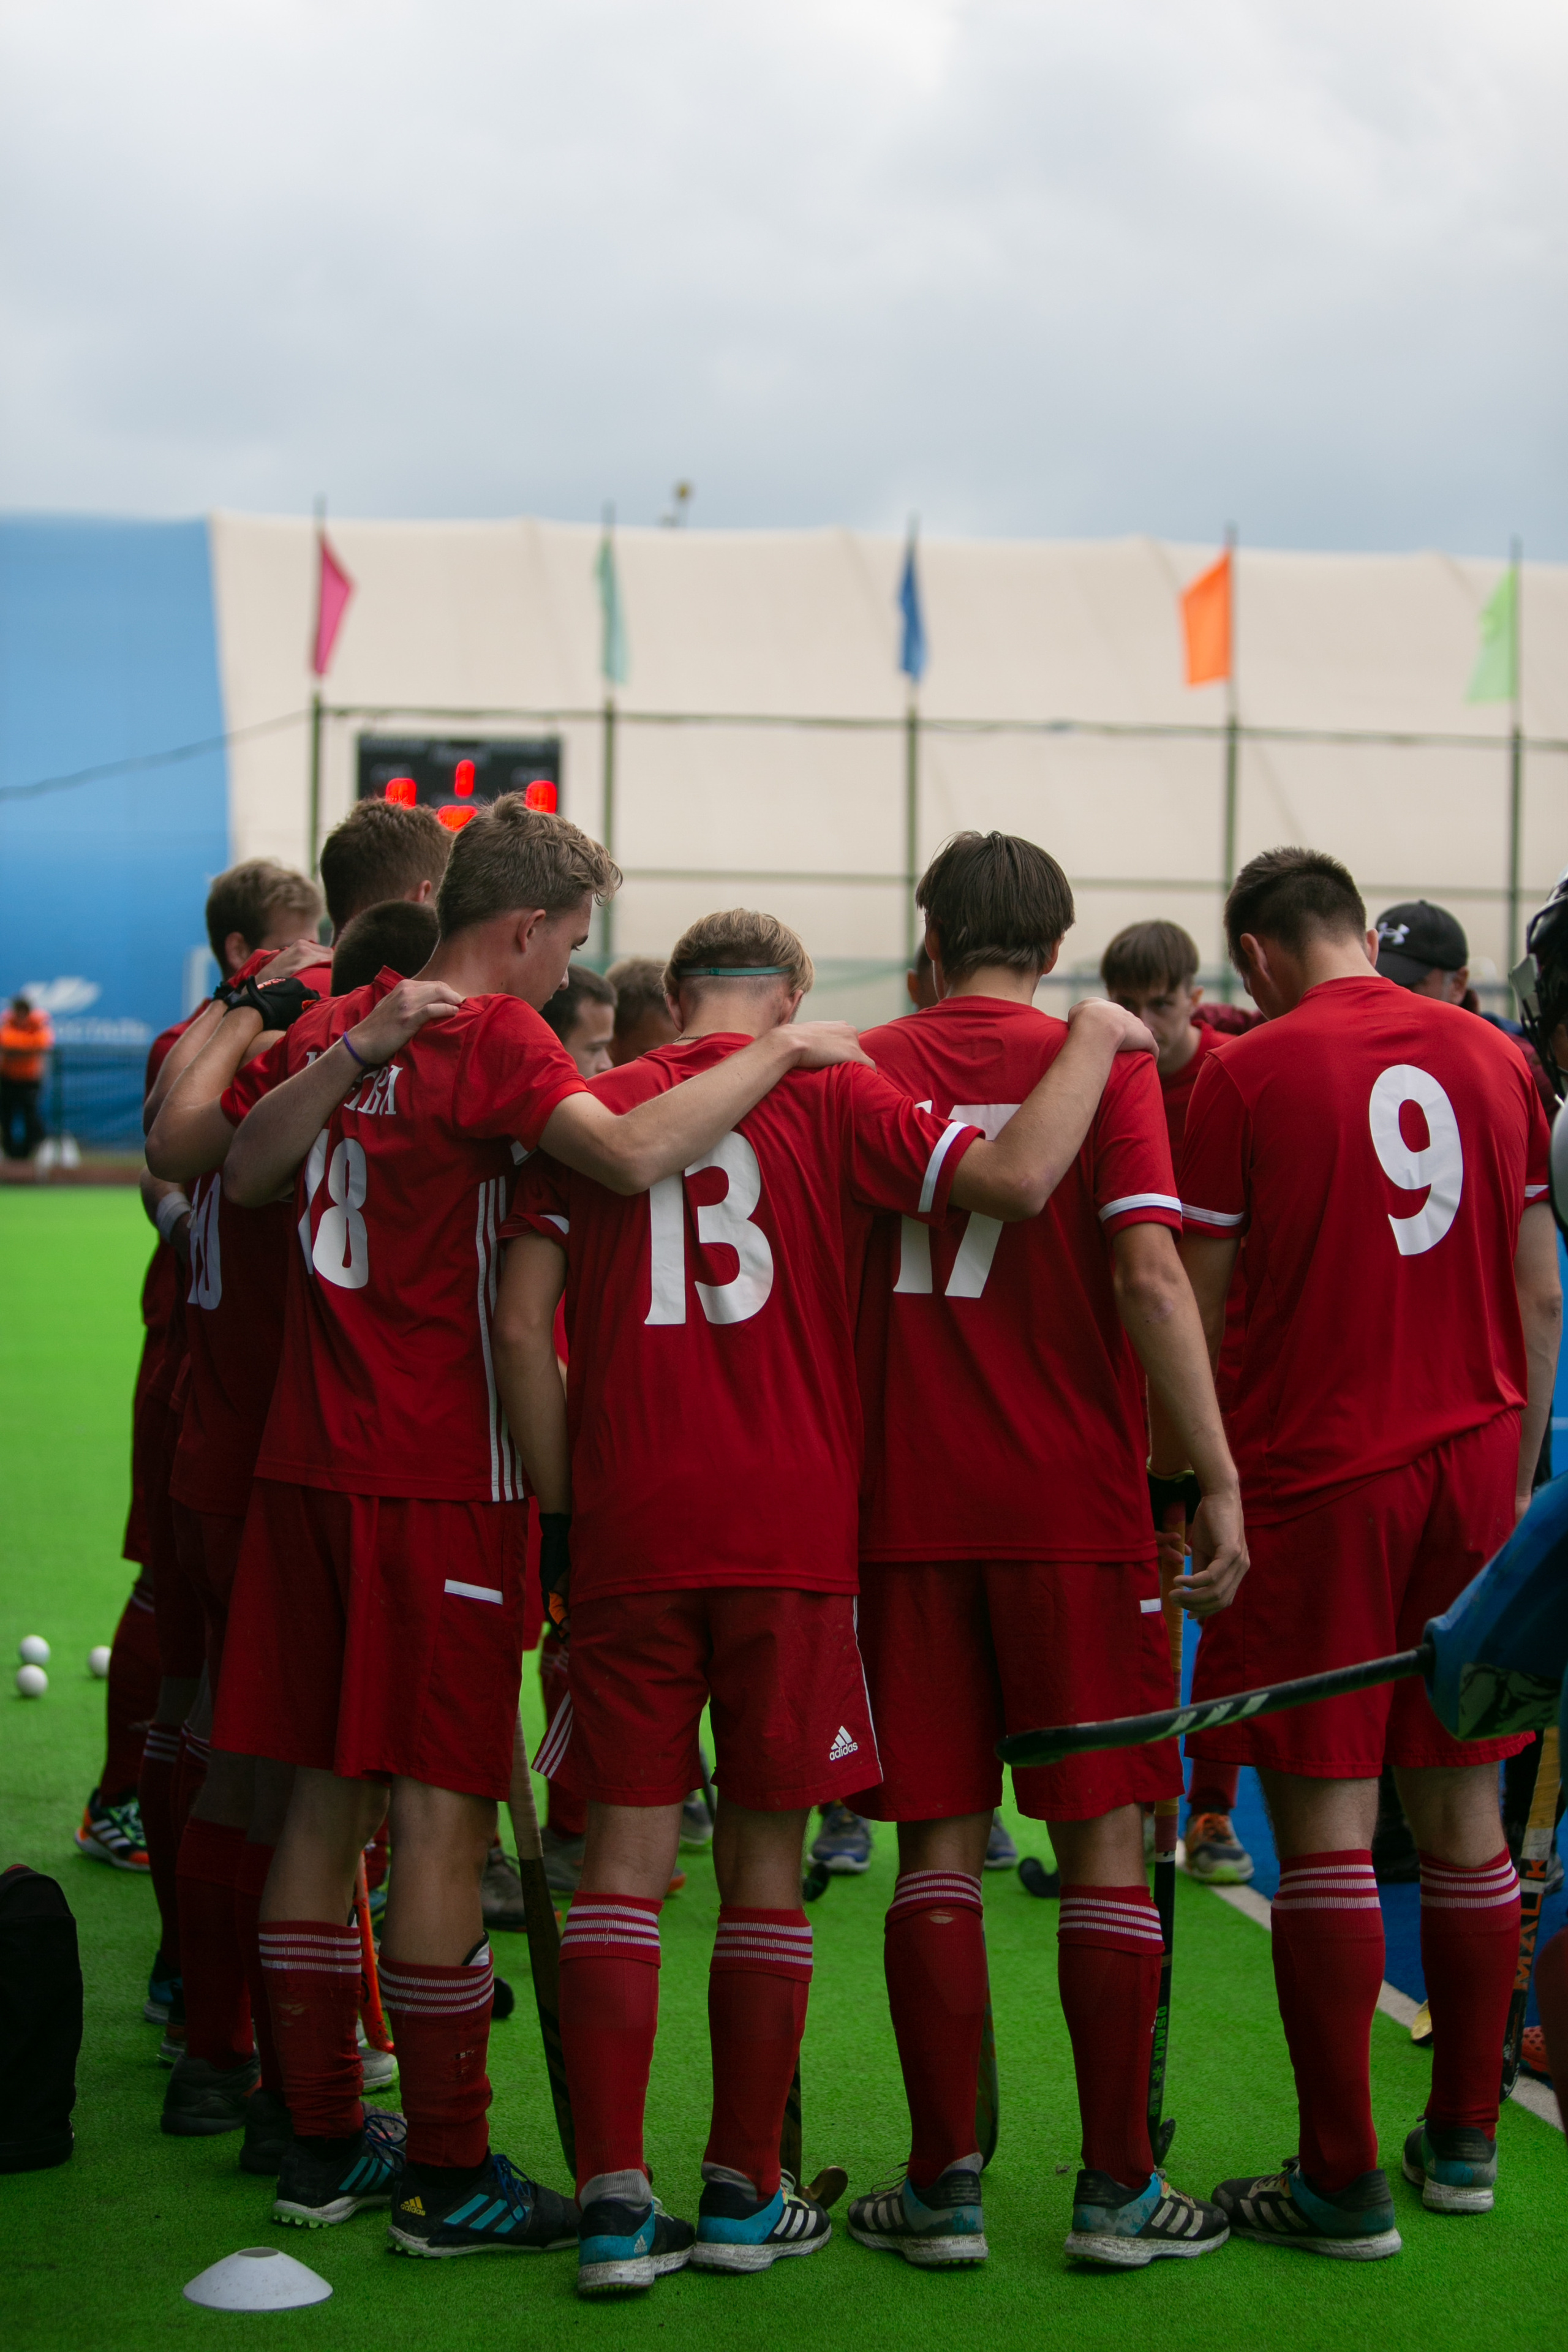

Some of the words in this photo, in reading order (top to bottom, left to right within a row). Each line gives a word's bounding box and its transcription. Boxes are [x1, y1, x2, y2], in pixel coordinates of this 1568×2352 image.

[298, 1129, 368, 1289] 18
[1369, 1065, 1463, 1256] 9
[644, 1130, 774, 1325] 13
[830, 1743, 858, 1760] adidas
[1513, 1860, 1547, 1991] MALK
[1154, 2006, 1167, 2060] OSAKA
[401, 2204, 426, 2216] adidas
